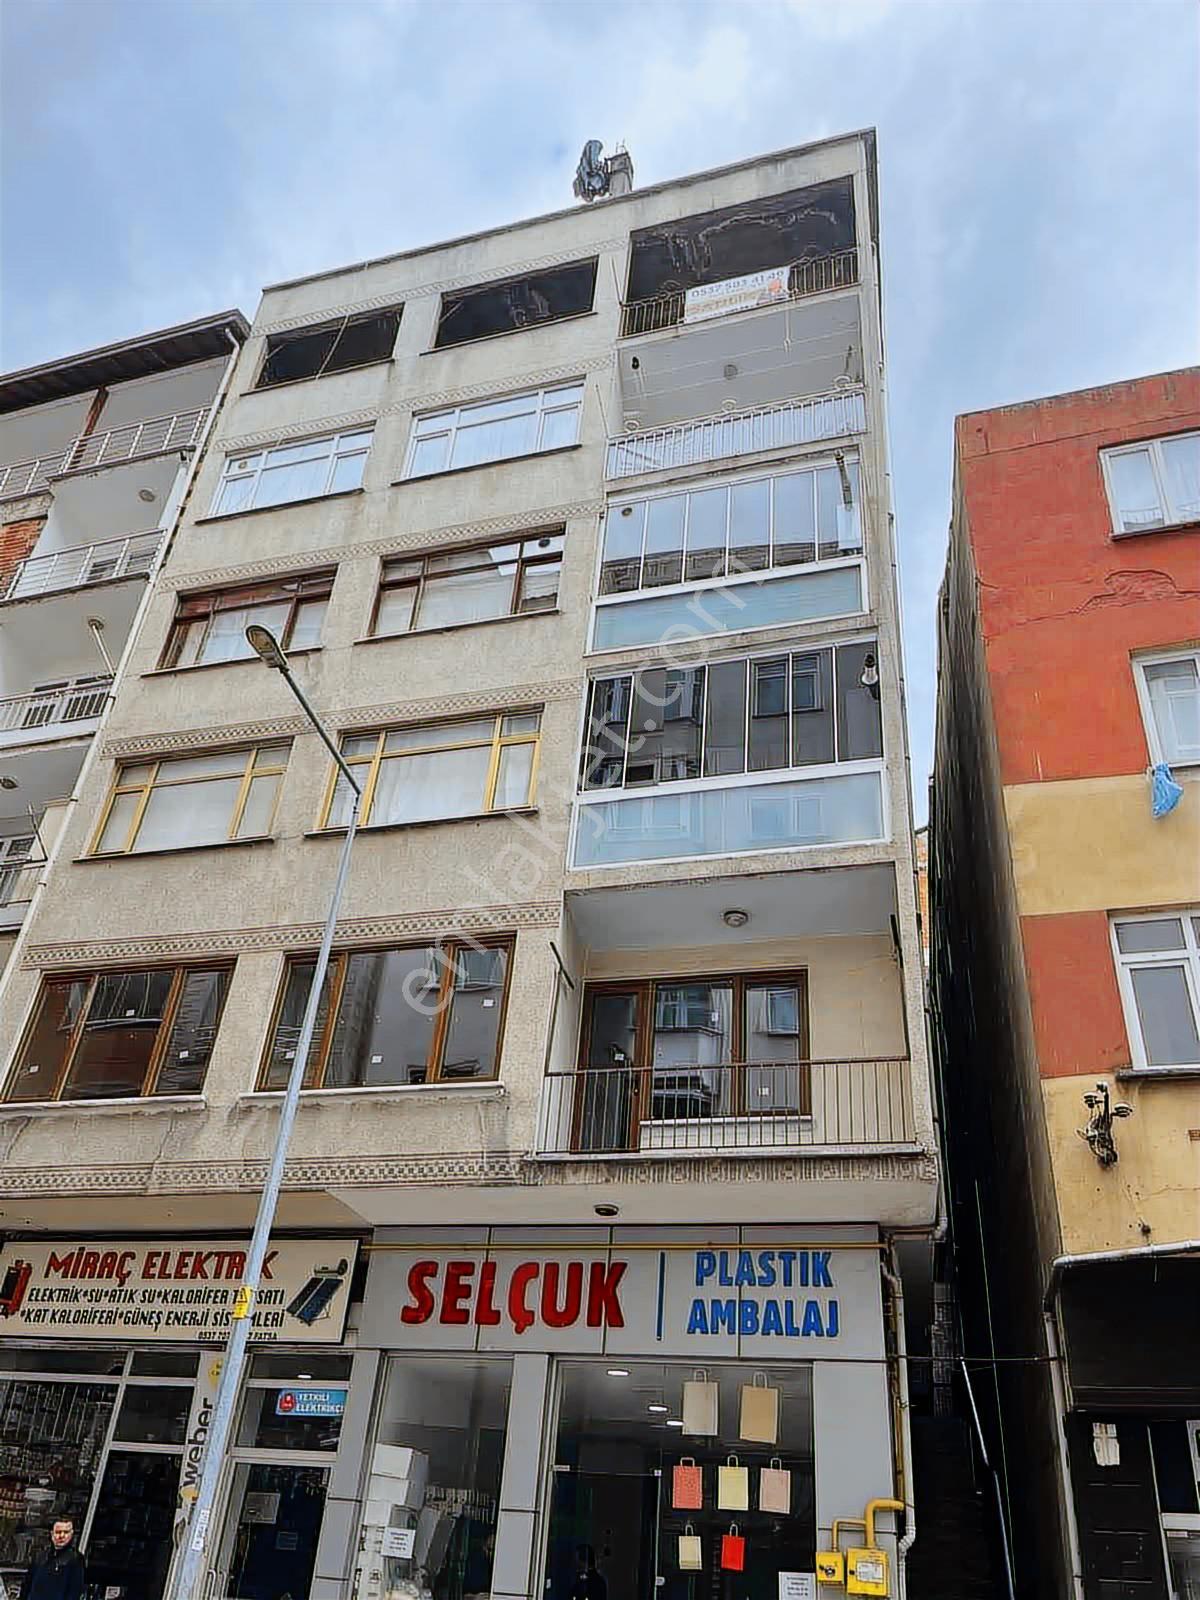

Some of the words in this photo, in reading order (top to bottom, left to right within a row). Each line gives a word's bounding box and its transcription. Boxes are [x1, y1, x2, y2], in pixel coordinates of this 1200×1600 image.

[44, 1246, 136, 1287] MİRAÇ
[141, 1251, 279, 1279] ELEKTRK
[165, 1308, 211, 1327] ENERJİ
[401, 1260, 628, 1334] SELÇUK
[687, 1299, 840, 1338] AMBALAJ
[183, 1398, 213, 1487] weber
